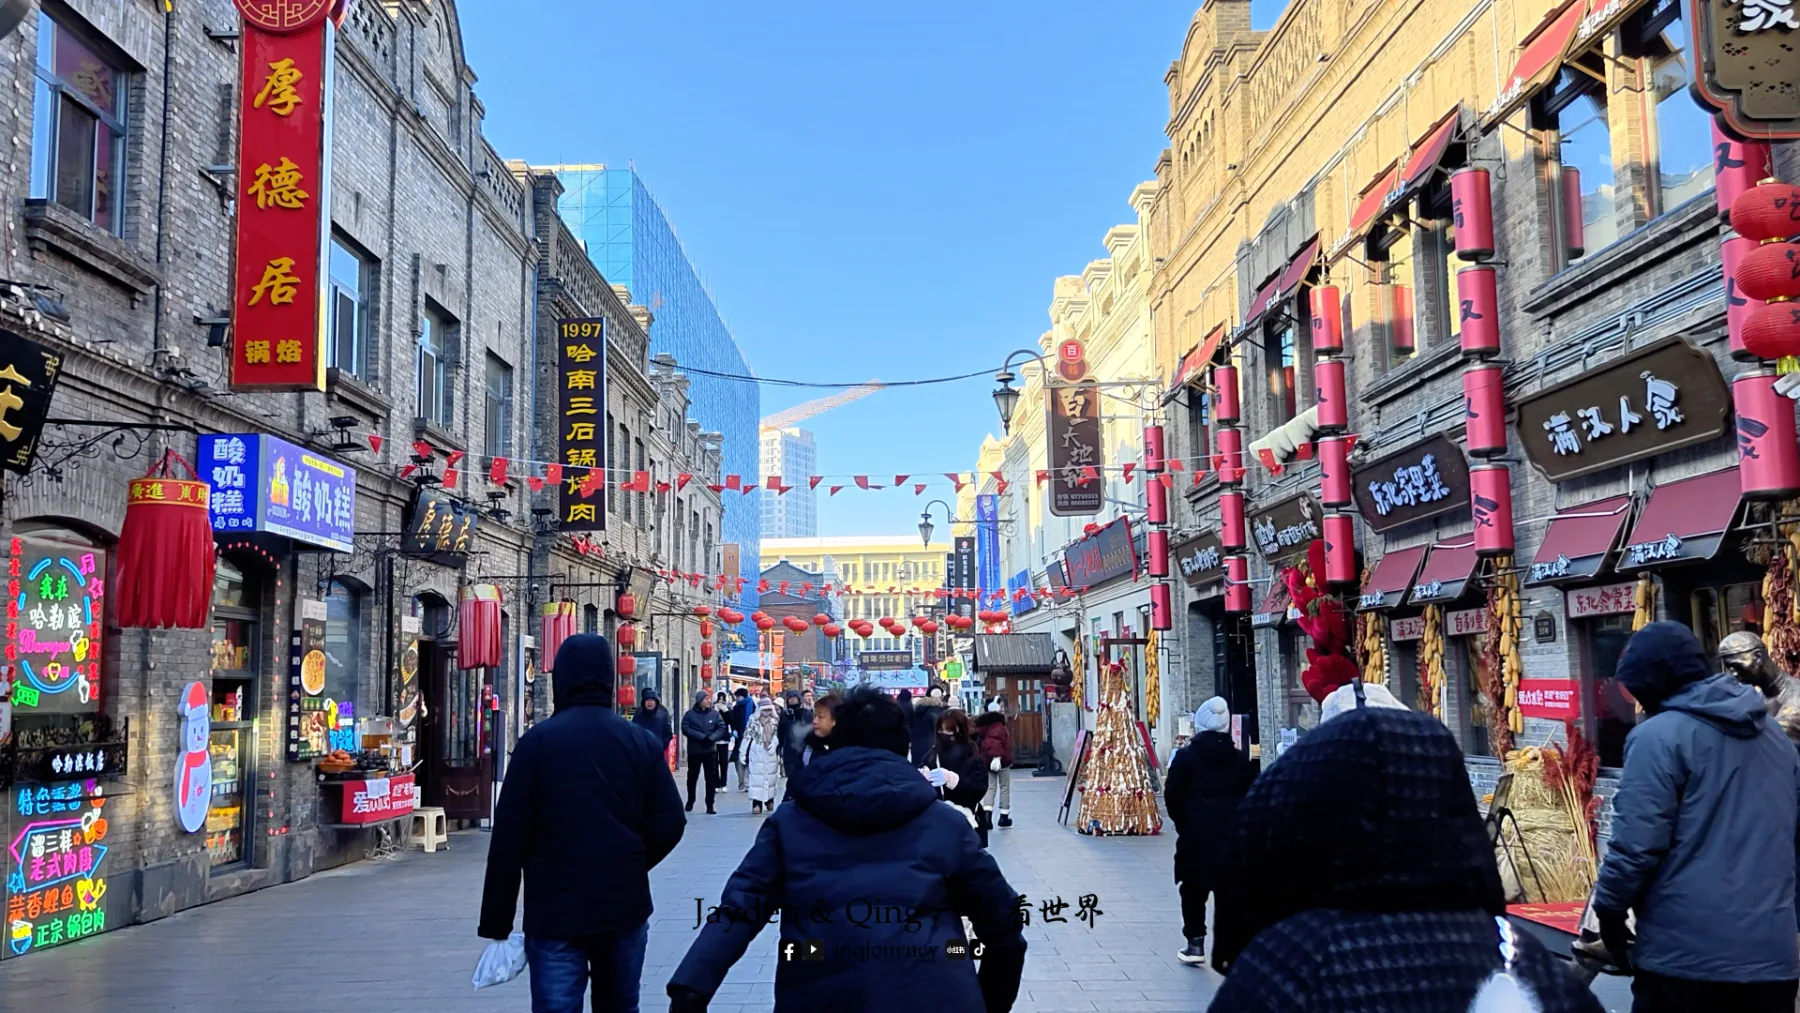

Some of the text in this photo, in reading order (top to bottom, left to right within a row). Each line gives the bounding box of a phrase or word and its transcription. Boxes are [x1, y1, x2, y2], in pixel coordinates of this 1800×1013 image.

[247, 58, 310, 307] 厚德居
[562, 323, 601, 338] 1997
[244, 340, 302, 364] 锅烙
[1542, 371, 1685, 456] 满汉人家
[212, 437, 246, 515] 酸奶糕
[292, 467, 351, 530] 酸奶糕
[30, 846, 93, 881] 老式肉段
[9, 885, 74, 922] 蒜香鲤鱼
[34, 907, 105, 948] 正宗 锅包肉
